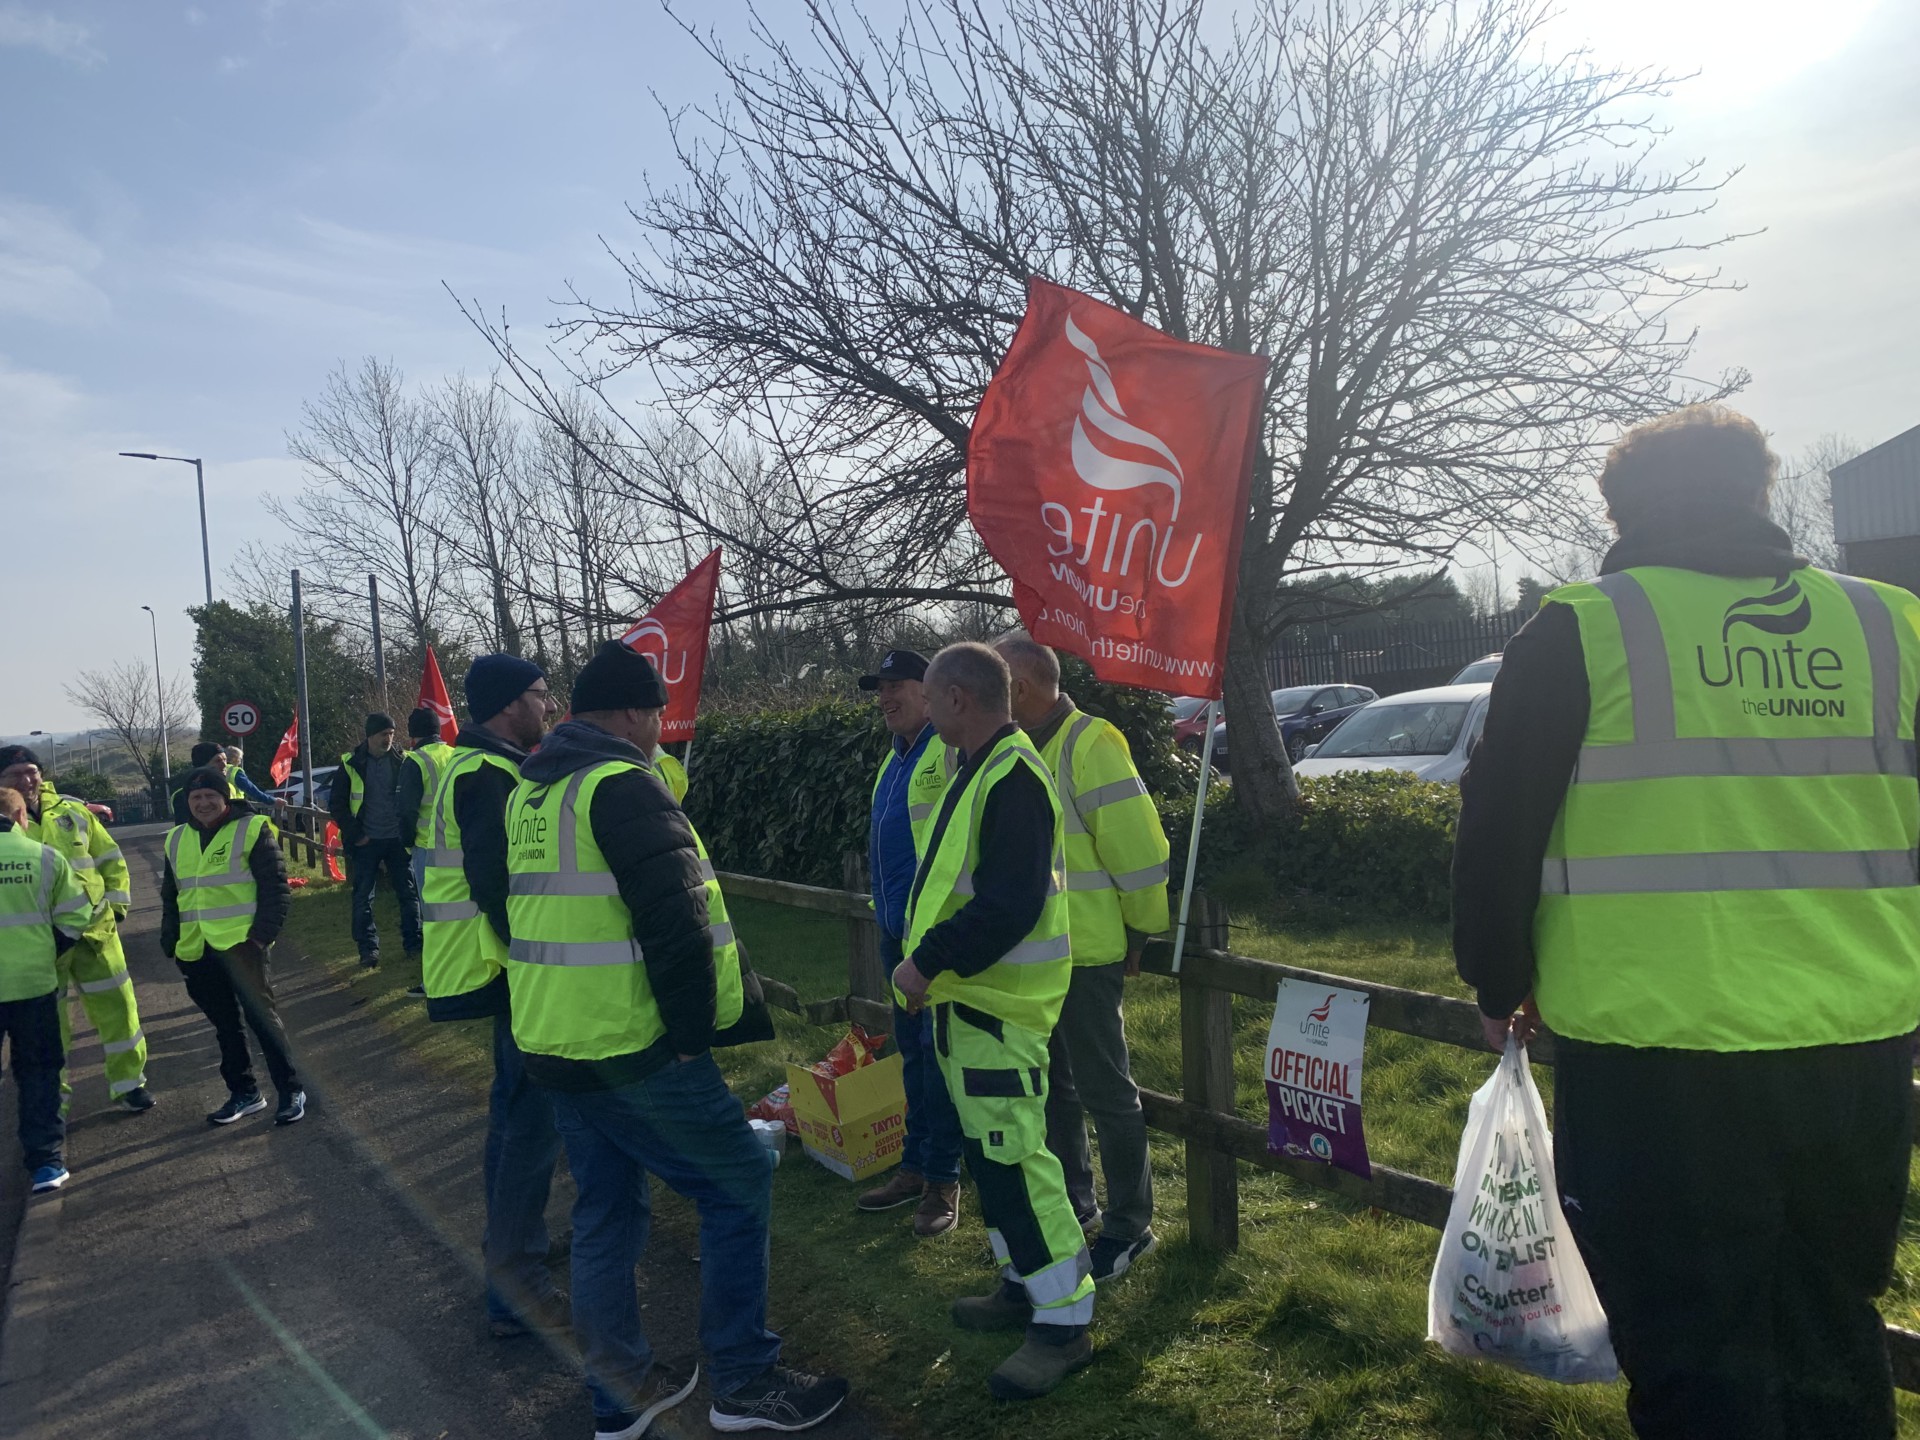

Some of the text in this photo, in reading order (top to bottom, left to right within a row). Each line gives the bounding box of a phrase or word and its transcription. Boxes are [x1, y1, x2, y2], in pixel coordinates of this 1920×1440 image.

[227, 711, 254, 726] 50
[1271, 1047, 1354, 1100] OFFICIAL
[1279, 1085, 1346, 1135] PICKET
[870, 1113, 902, 1136] TAYTO
[876, 1139, 902, 1158] CRISP
[1519, 1310, 1541, 1325] you
[1544, 1303, 1562, 1317] live
